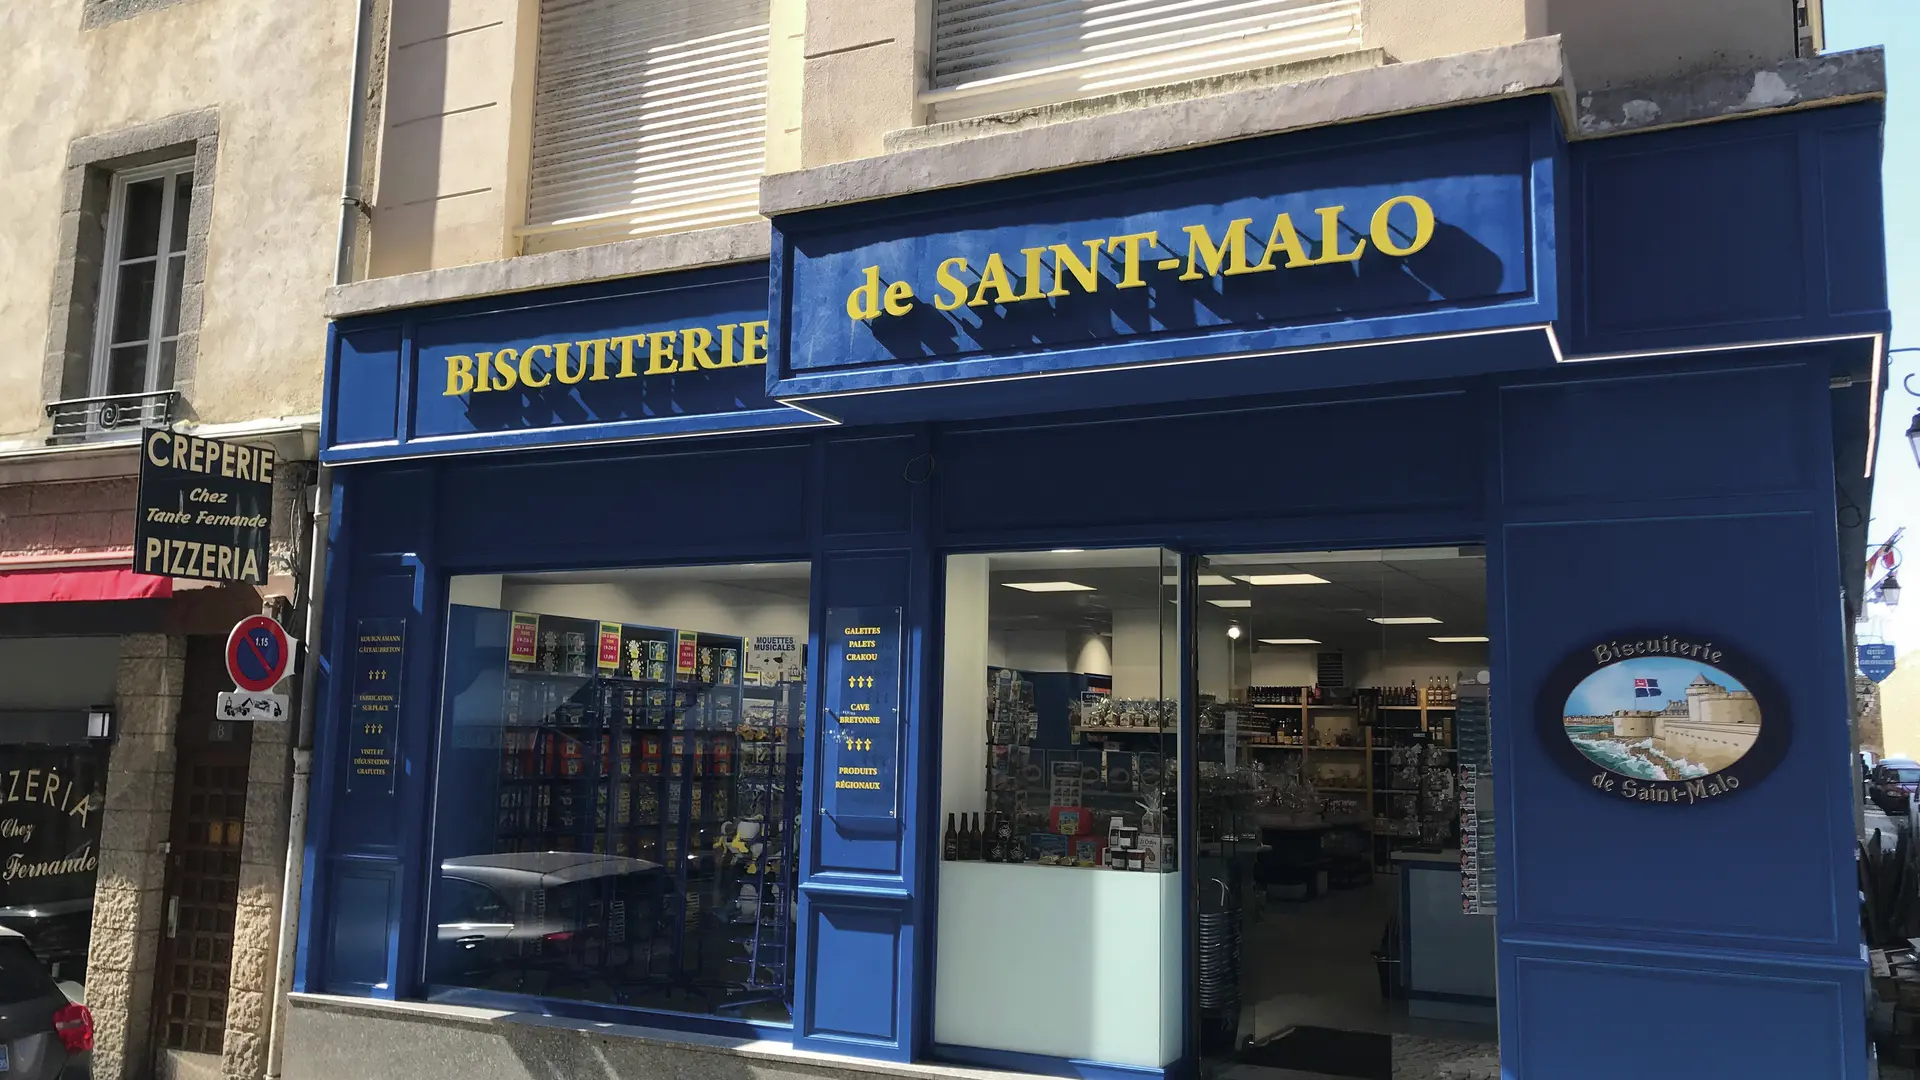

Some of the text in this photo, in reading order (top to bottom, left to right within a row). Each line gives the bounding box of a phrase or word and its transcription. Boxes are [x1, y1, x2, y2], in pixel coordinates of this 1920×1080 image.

[846, 194, 1435, 321] de SAINT-MALO
[442, 320, 769, 397] BISCUITERIE
[147, 431, 274, 484] CREPERIE
[189, 488, 228, 504] Chez
[147, 508, 267, 528] Tante Fernande
[145, 537, 260, 582] PIZZERIA
[756, 636, 794, 644] MOUETTES
[844, 627, 881, 635] GALETTES
[848, 640, 876, 648] PALETS
[1592, 635, 1723, 664] Biscuiterie
[846, 653, 878, 661] CRAKOU
[850, 703, 870, 711] CAVE
[839, 716, 880, 724] BRETONNE
[838, 766, 878, 775] PRODUITS
[835, 780, 880, 789] RÉGIONAUX
[1591, 772, 1740, 804] de Saint-Malo
[0, 768, 90, 829] ZERIA
[0, 818, 34, 844] Chez
[2, 853, 98, 881] Fernande
